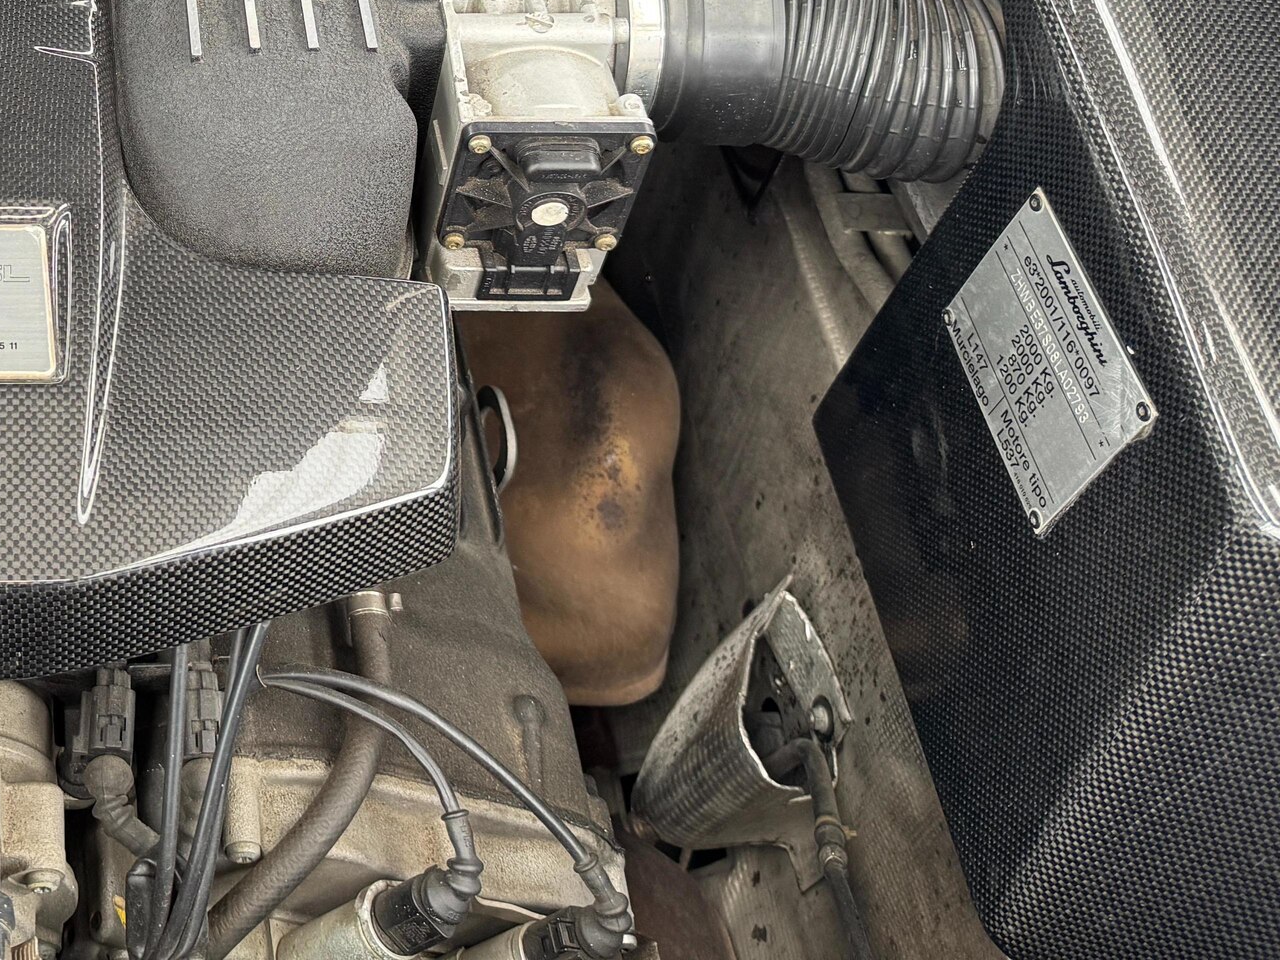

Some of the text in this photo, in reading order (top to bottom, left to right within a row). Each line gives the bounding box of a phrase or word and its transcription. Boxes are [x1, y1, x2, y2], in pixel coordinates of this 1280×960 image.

[1046, 252, 1108, 369] Lamborghini
[1070, 275, 1101, 332] automobili
[948, 318, 991, 410] Murcielago
[966, 332, 988, 374] L147
[1009, 266, 1090, 425] ZHWBE37S08LA02793
[1011, 332, 1049, 410] 2000 Kg.
[1019, 322, 1058, 401] 2000 Kg.
[995, 352, 1032, 429] 1200 Kg.
[1007, 351, 1041, 420] 870 Kg.
[996, 427, 1019, 472] L537
[1000, 408, 1048, 511] Motore tipo
